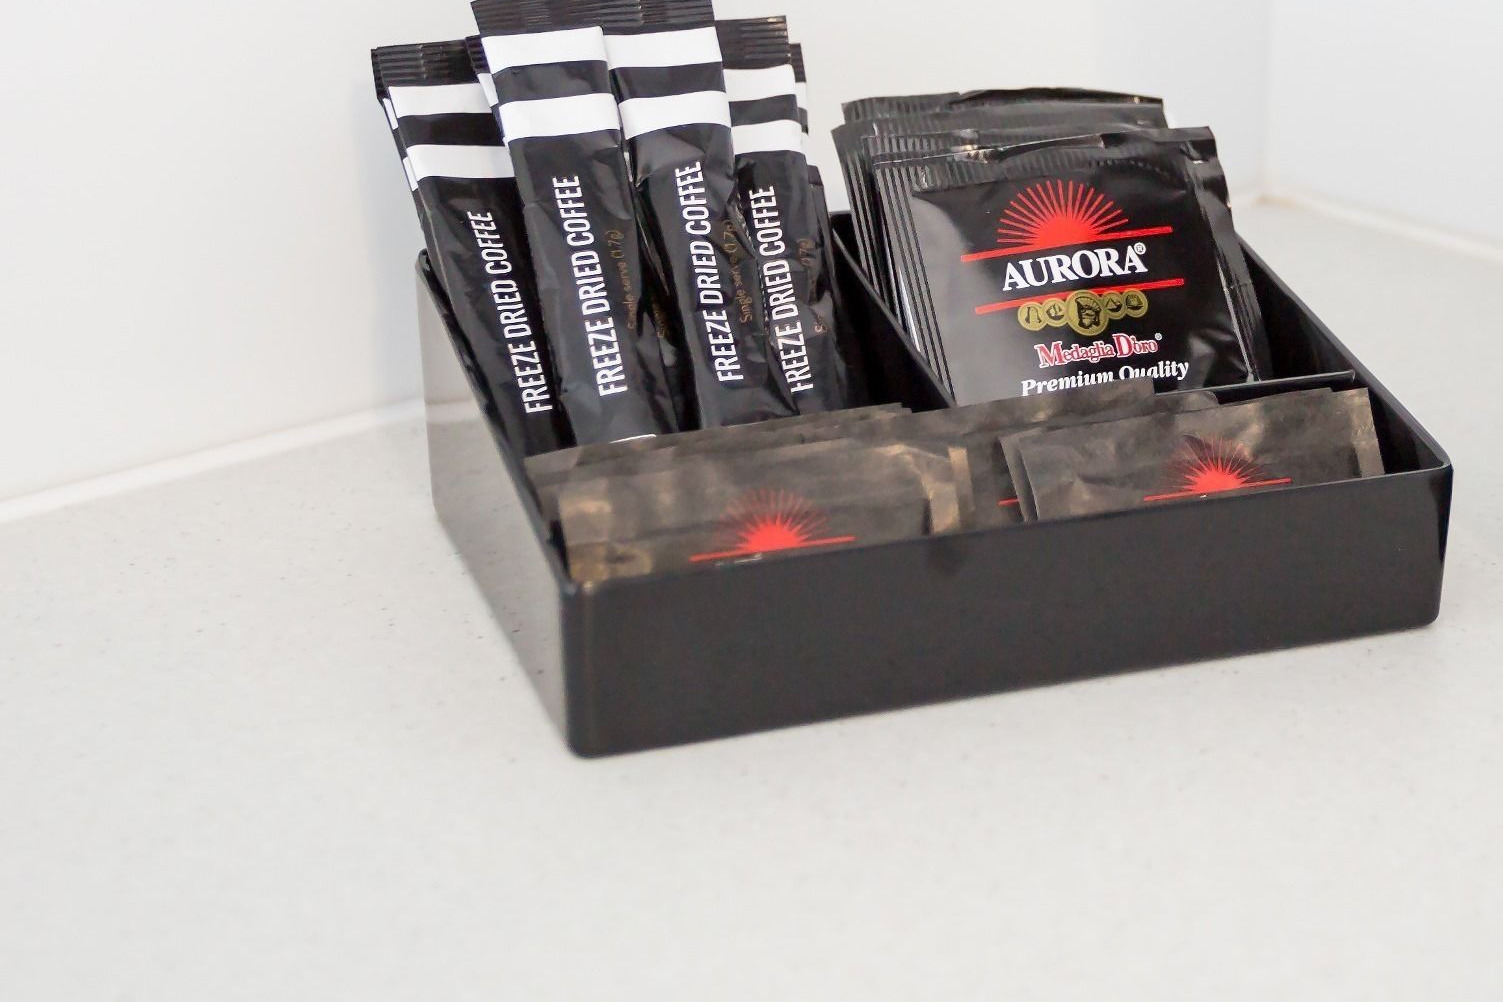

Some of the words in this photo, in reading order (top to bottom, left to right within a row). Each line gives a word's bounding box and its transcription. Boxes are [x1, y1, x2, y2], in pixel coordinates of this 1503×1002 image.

[552, 175, 595, 247] COFFEE
[674, 161, 712, 235] COFFEE
[748, 185, 786, 257] COFFEE
[466, 211, 512, 275] COFFEE
[689, 240, 724, 304] DRIED
[1002, 245, 1148, 291] AURORA
[490, 279, 532, 339] DRIED
[570, 250, 611, 315] DRIED
[762, 259, 798, 321] DRIED
[507, 340, 553, 414] FREEZE
[585, 316, 628, 397] FREEZE
[703, 309, 744, 382] FREEZE
[775, 321, 814, 393] FREEZE
[1034, 340, 1116, 368] Medaglia
[1020, 370, 1114, 397] Premium
